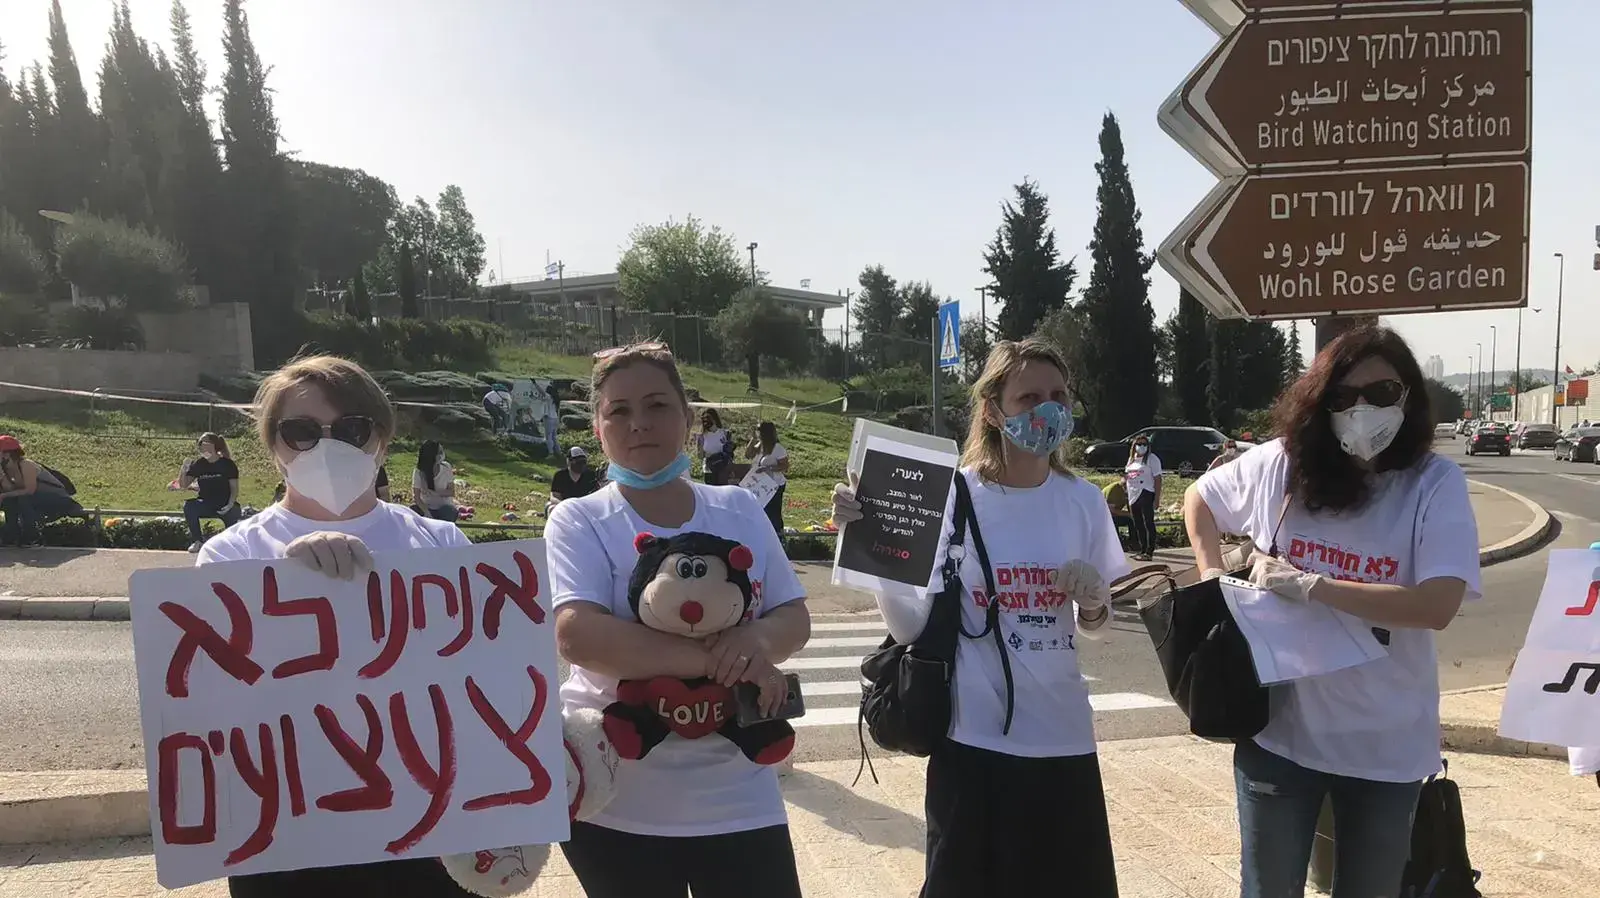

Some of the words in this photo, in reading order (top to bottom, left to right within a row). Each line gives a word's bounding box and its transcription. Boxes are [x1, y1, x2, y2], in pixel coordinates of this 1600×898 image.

[1268, 36, 1350, 66] ציפורים
[1358, 26, 1418, 68] לחקר
[1425, 29, 1500, 59] התחנה
[1275, 80, 1348, 116] الطيور
[1361, 66, 1428, 104] أبحاث
[1439, 73, 1496, 108] مركز
[1257, 121, 1304, 149] Bird
[1313, 115, 1419, 148] Watching
[1427, 113, 1511, 140] Station
[1271, 181, 1375, 219] לוורדים
[1386, 180, 1463, 213] וואהל
[1474, 182, 1495, 217] גן
[1263, 230, 1346, 268] للورود
[1359, 228, 1408, 262] قول
[1423, 227, 1501, 255] حديقه
[1259, 272, 1322, 299] Wohl
[1332, 270, 1396, 296] Rose
[1407, 264, 1505, 292] Garden
[891, 467, 924, 481] לצערי,
[1290, 538, 1360, 573] חוזרים
[1364, 556, 1399, 577] לא
[357, 550, 546, 679] אנחנו
[972, 590, 1029, 608] תנאם
[158, 566, 340, 698] לא
[657, 698, 724, 726] LOVE
[158, 665, 552, 867] צעצועים
